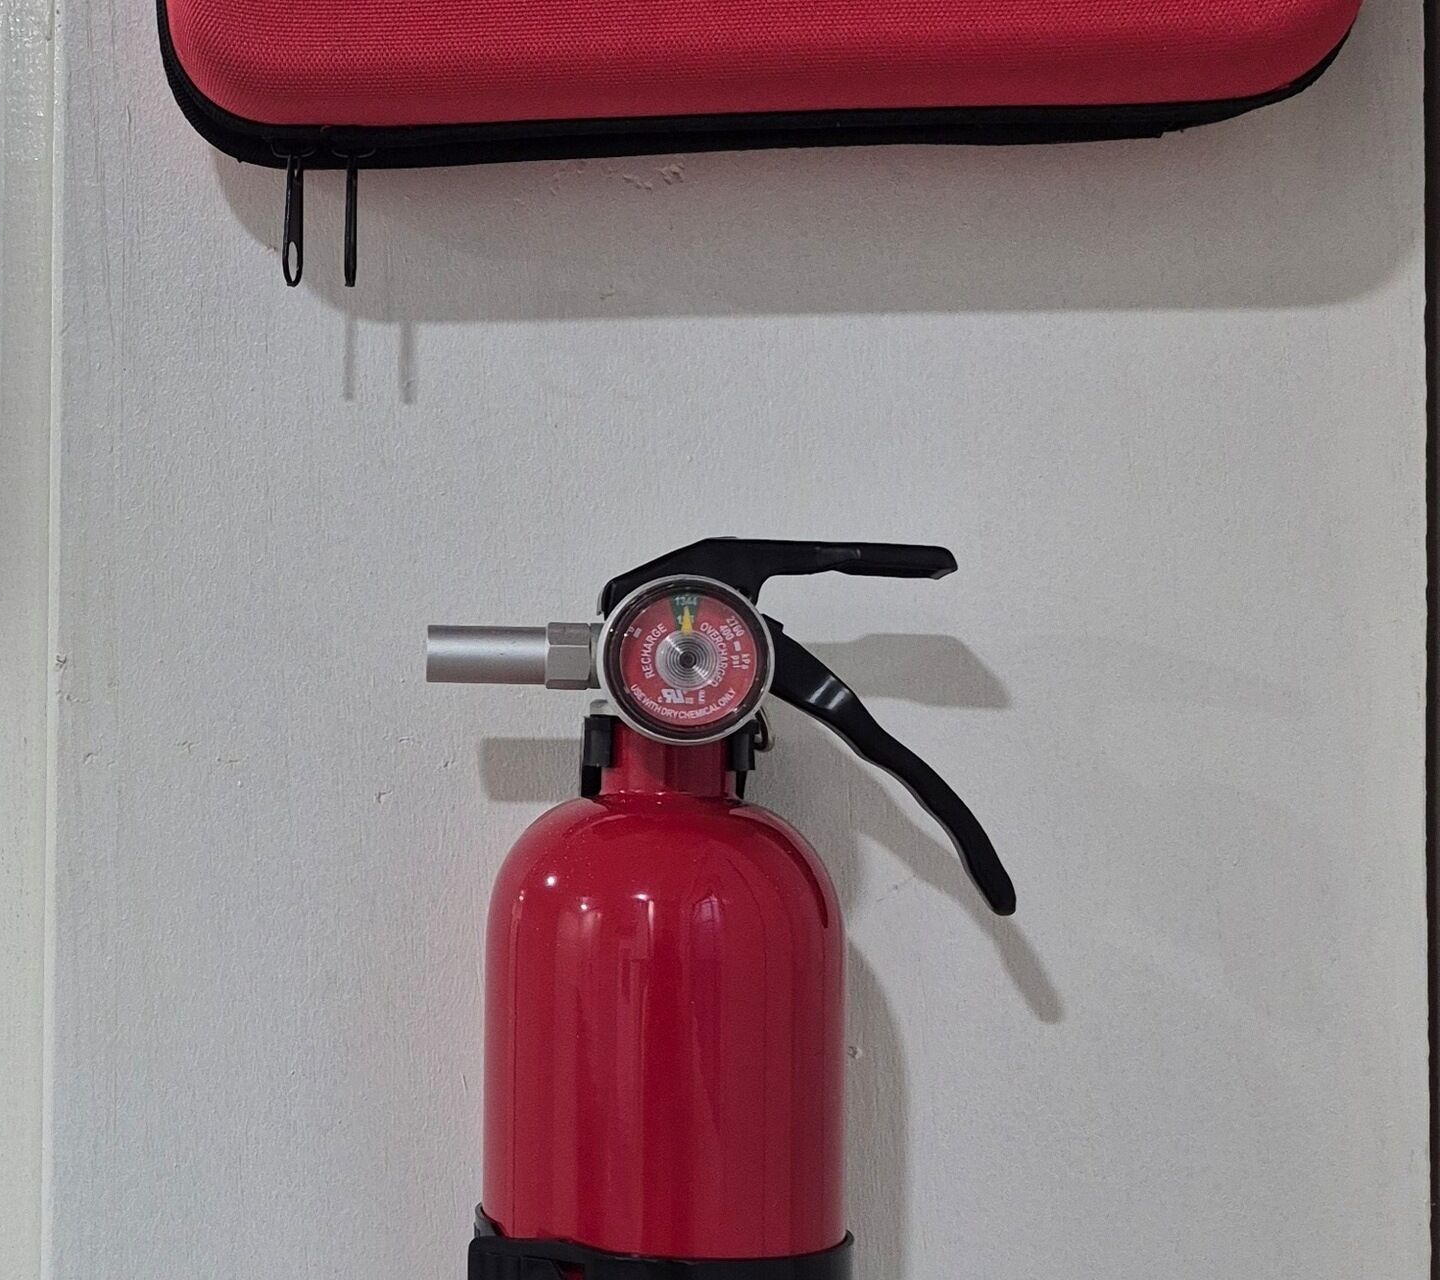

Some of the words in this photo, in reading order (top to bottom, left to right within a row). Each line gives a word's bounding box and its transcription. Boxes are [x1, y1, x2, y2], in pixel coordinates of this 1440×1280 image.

[640, 623, 667, 679] RECHARGE
[661, 707, 679, 718] DRY
[678, 703, 720, 719] CHEMICAL
